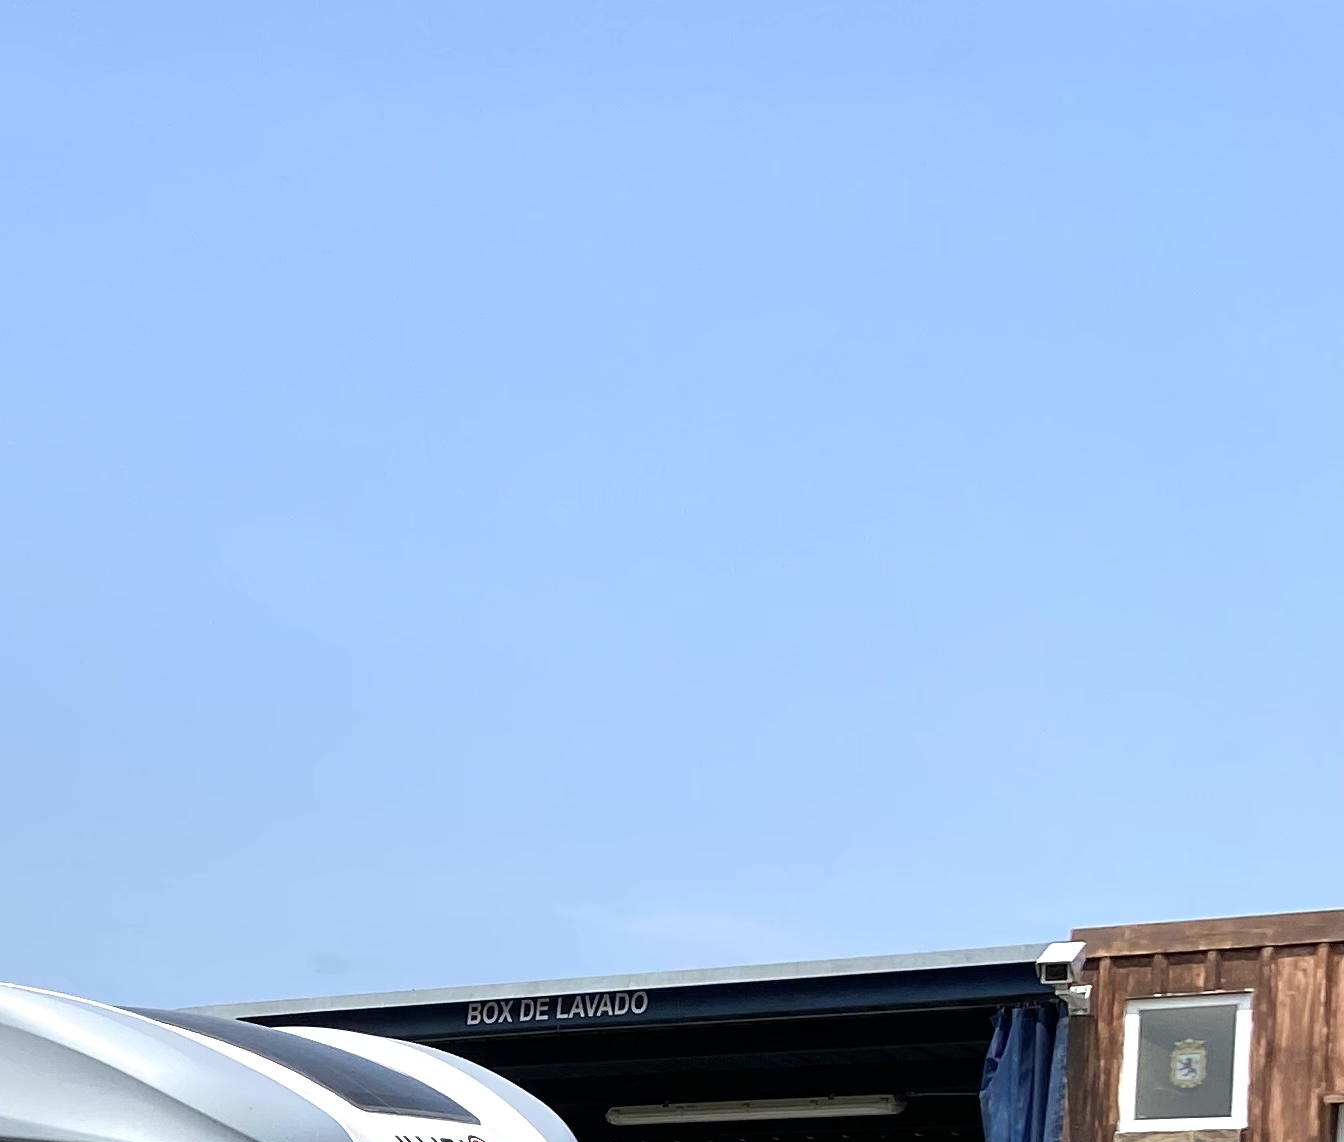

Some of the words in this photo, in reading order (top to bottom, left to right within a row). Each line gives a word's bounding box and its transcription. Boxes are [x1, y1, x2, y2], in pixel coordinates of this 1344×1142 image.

[467, 1000, 514, 1025] BOX
[519, 998, 551, 1022] DE
[556, 991, 649, 1019] LAVADO
